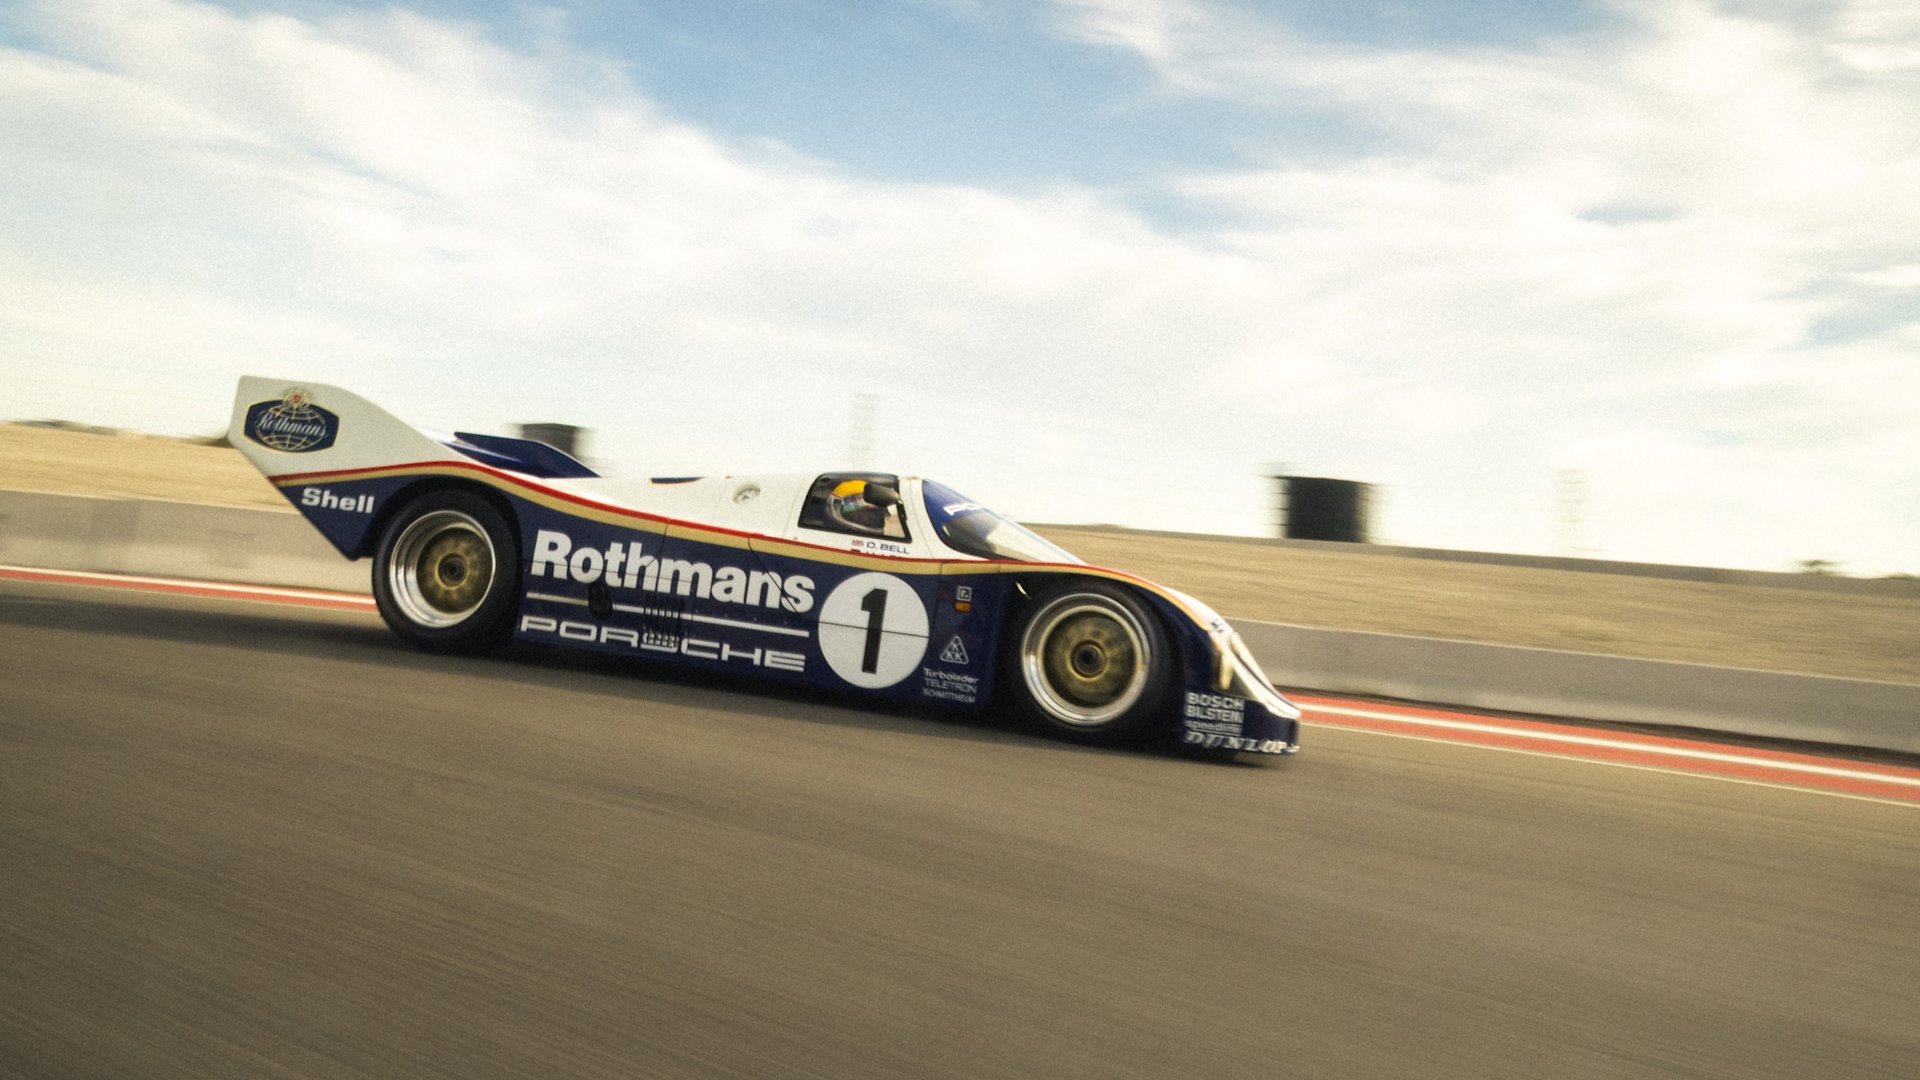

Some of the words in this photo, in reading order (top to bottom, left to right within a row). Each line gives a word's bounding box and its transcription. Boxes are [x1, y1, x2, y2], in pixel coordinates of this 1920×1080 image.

[257, 412, 326, 438] Rothmans
[302, 487, 374, 513] Shell
[880, 543, 910, 555] BELL
[531, 529, 816, 613] Rothmans
[520, 615, 806, 672] PORSCHE
[861, 588, 888, 674] 1
[923, 667, 980, 684] Turbolader
[1185, 692, 1245, 711] BOSCH
[1185, 704, 1244, 723] BILSTEIN
[1184, 730, 1288, 754] DUNLOP
